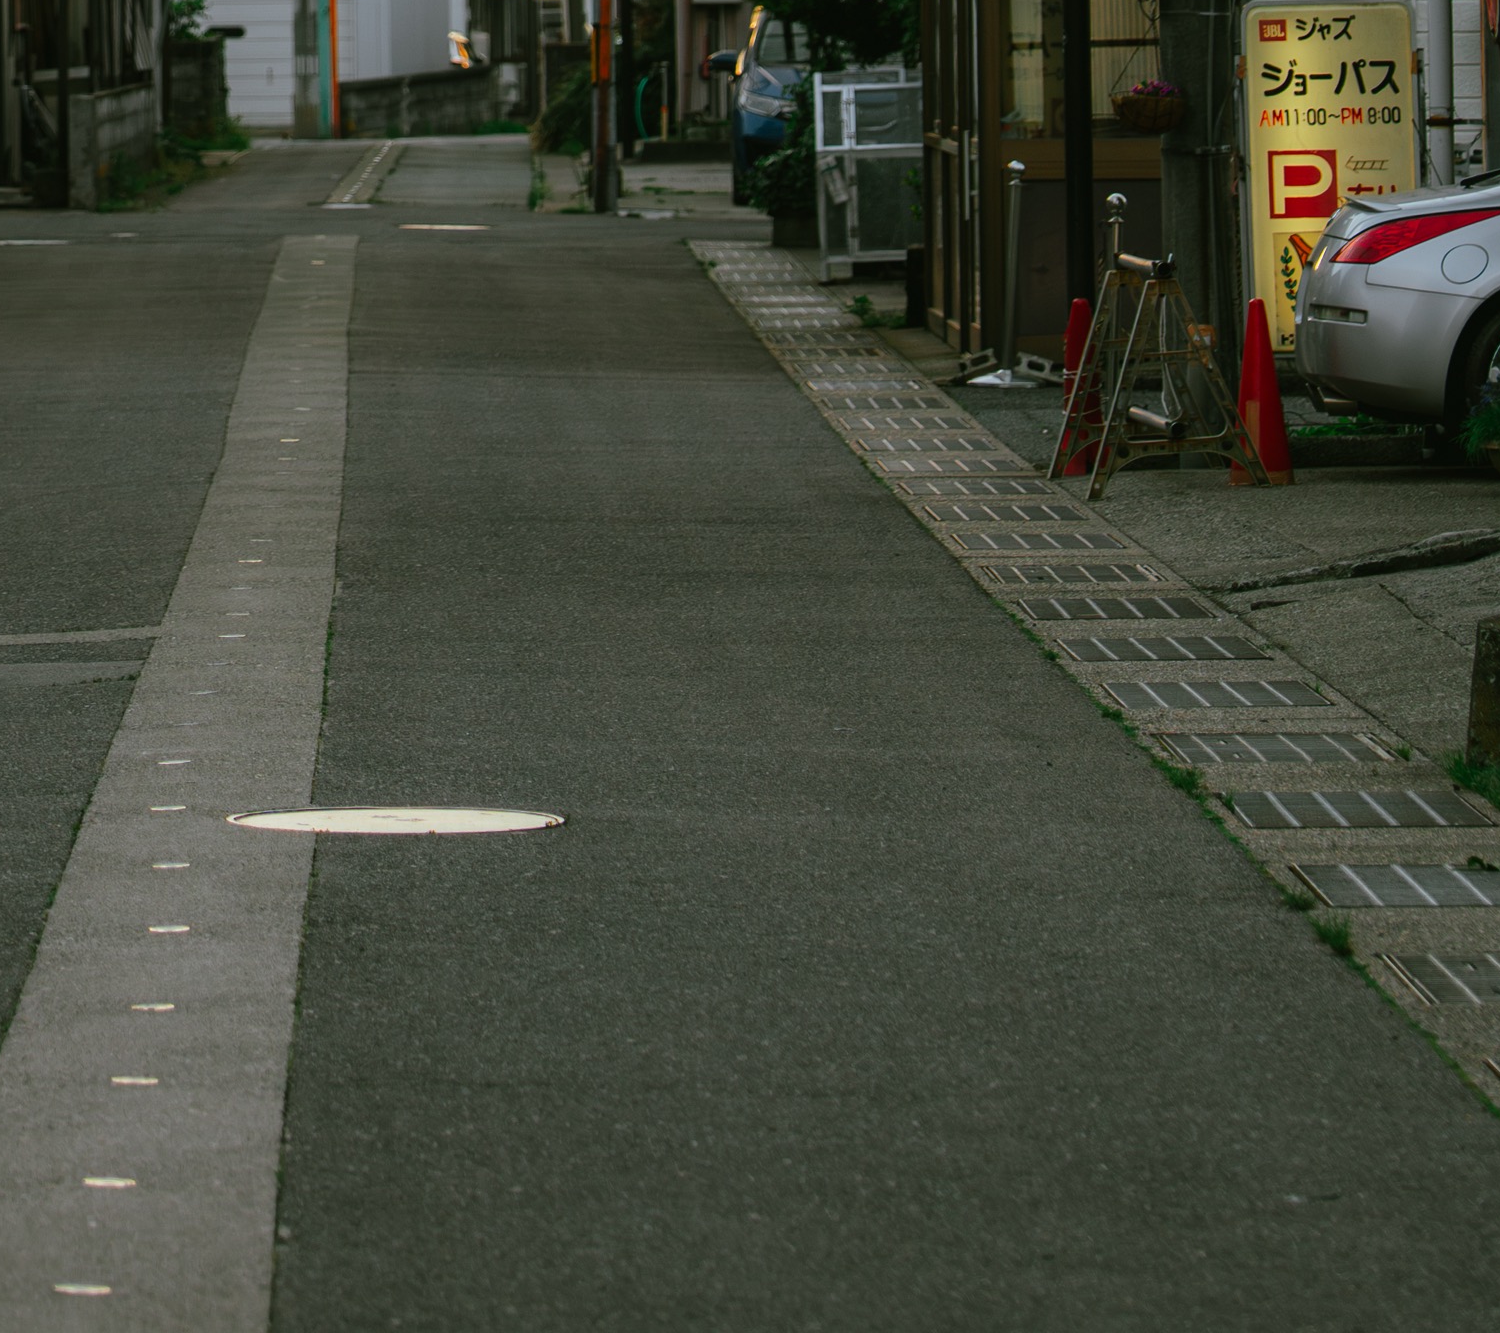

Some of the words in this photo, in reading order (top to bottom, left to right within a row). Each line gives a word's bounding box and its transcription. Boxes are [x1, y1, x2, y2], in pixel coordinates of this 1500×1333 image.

[1263, 23, 1285, 39] JBL
[1295, 14, 1356, 41] ジャズ
[1260, 58, 1400, 96] ジョーパス
[1272, 154, 1333, 215] P
